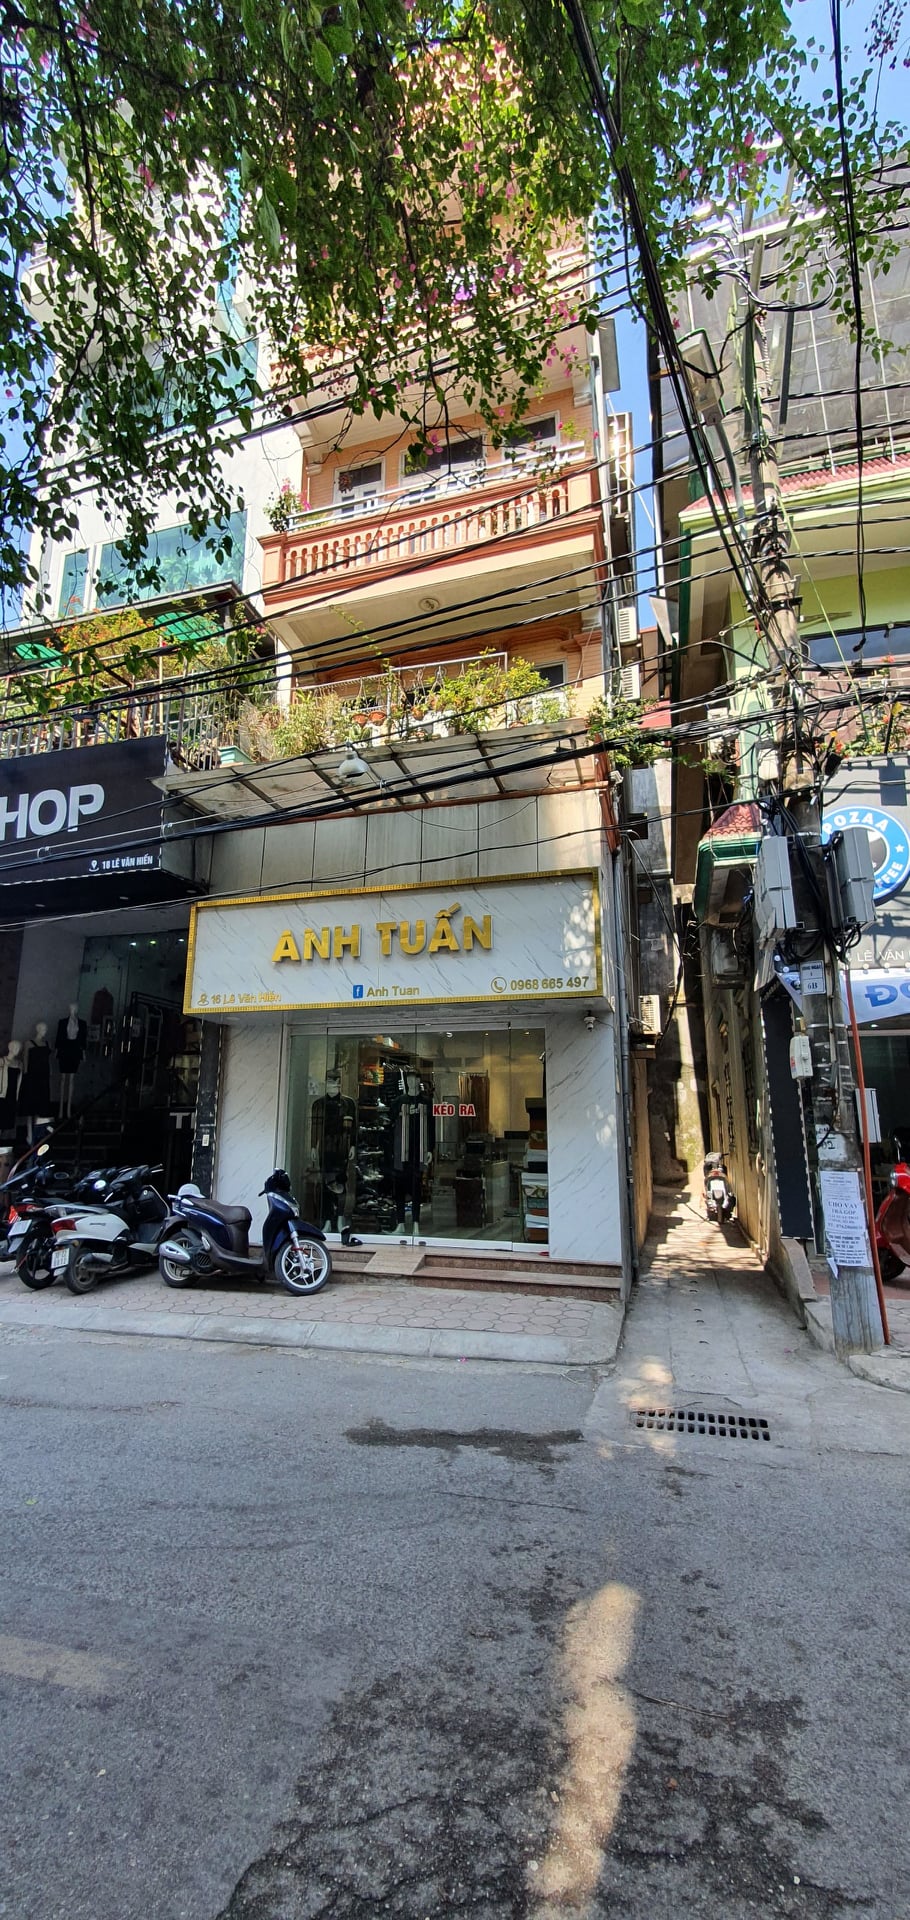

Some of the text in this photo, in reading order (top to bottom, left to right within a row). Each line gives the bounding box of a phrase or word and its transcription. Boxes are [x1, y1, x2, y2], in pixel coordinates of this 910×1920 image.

[271, 902, 493, 963] ANH TUẤN
[857, 949, 905, 962] LÊ VĂN
[510, 976, 590, 991] 0968 665 497
[366, 986, 389, 998] Anh
[391, 985, 420, 997] Tuan
[210, 993, 221, 1005] 16
[432, 1101, 456, 1117] KÉO
[459, 1103, 476, 1117] RA
